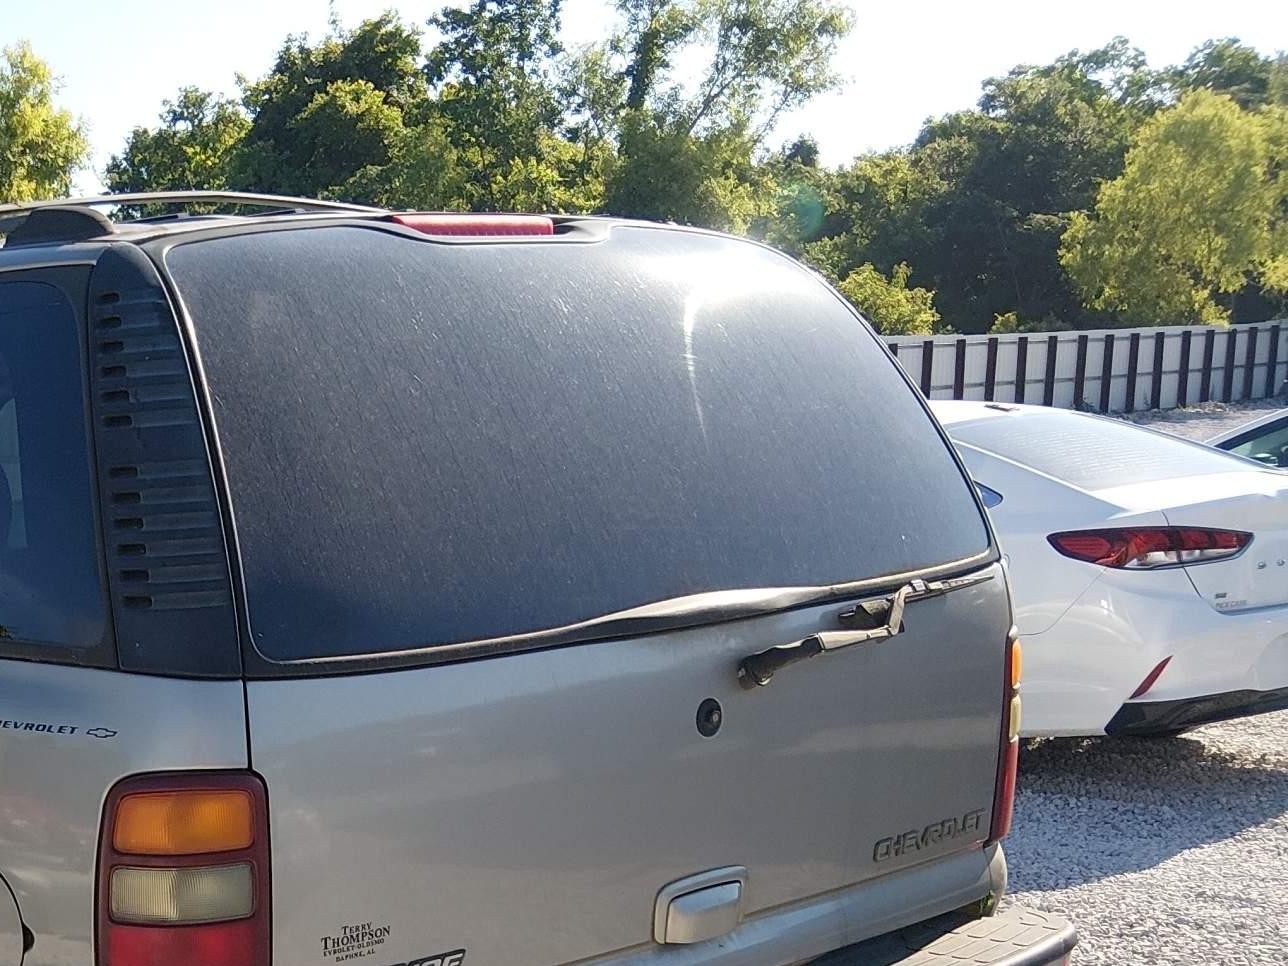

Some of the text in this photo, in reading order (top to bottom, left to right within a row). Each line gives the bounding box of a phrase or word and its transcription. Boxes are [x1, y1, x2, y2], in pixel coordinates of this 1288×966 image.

[873, 808, 986, 862] CHEVROLET
[320, 925, 391, 950] THOMPSON
[341, 921, 373, 936] TERRY
[366, 947, 376, 956] AL
